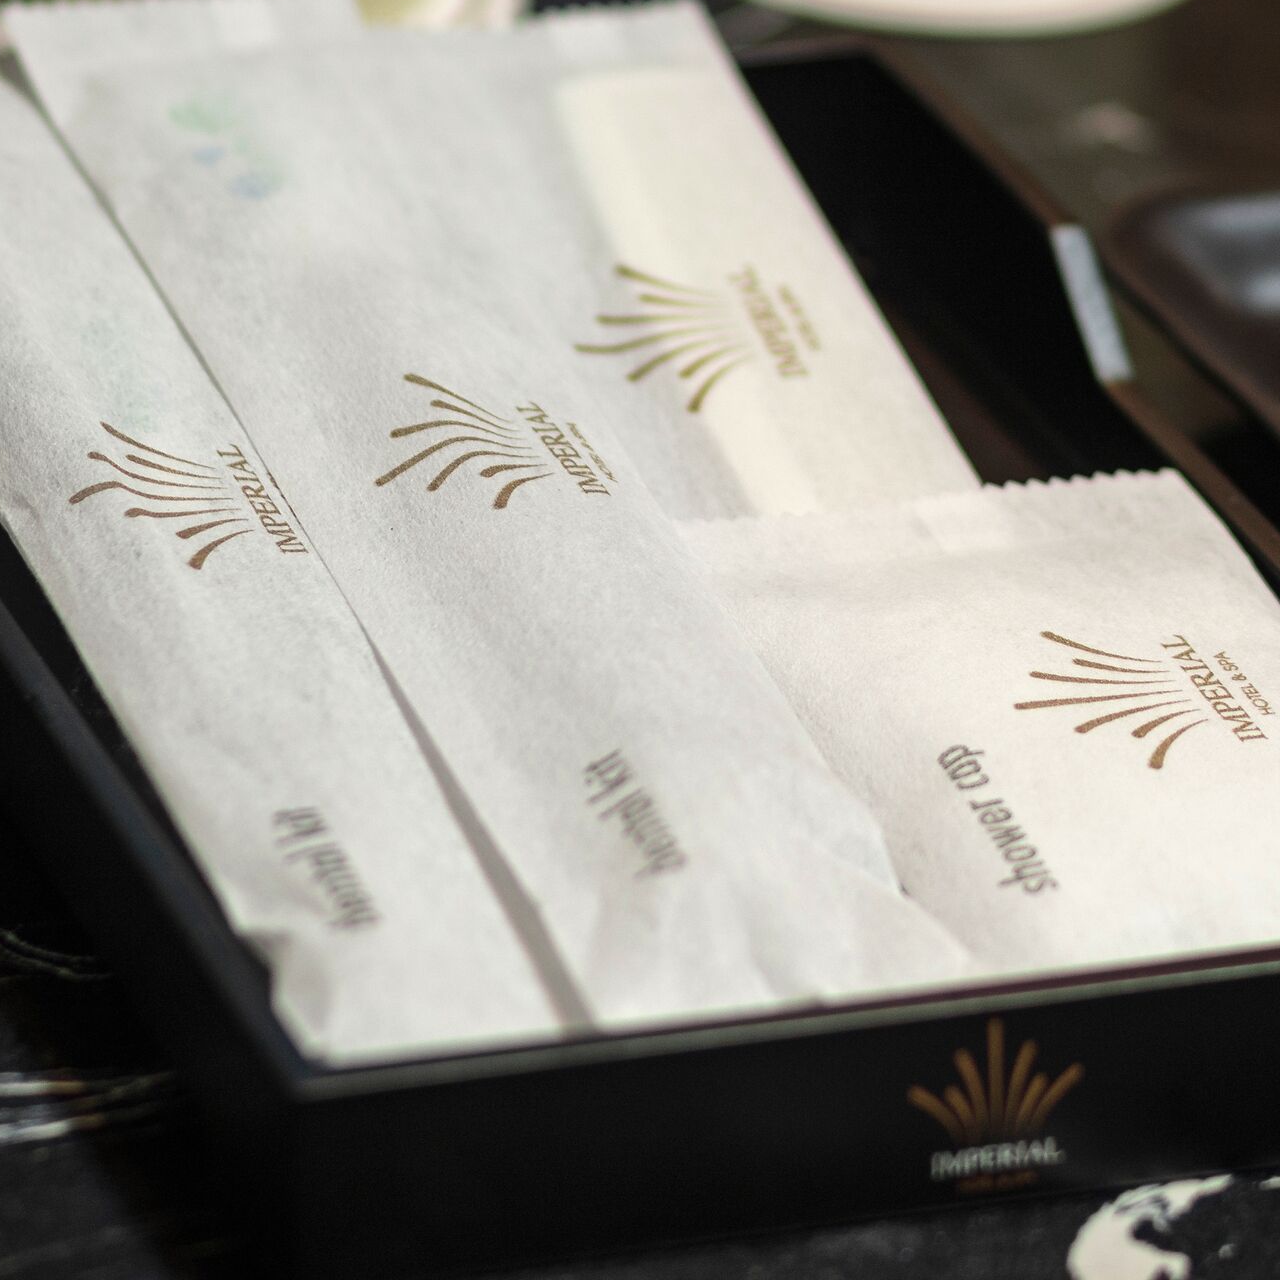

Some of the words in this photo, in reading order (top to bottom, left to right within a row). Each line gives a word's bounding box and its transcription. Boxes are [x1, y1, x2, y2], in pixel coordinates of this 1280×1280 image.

[516, 401, 611, 496] IMPERIAL
[216, 444, 308, 554] IMPERIAL
[1213, 650, 1239, 671] SPA
[1231, 672, 1247, 681] &
[1161, 634, 1269, 742] IMPERIAL
[1240, 682, 1276, 715] HOTEL
[584, 748, 632, 806] kit
[937, 743, 990, 791] cap
[971, 797, 1060, 895] shower
[930, 1135, 1066, 1181] IMPERIAL
